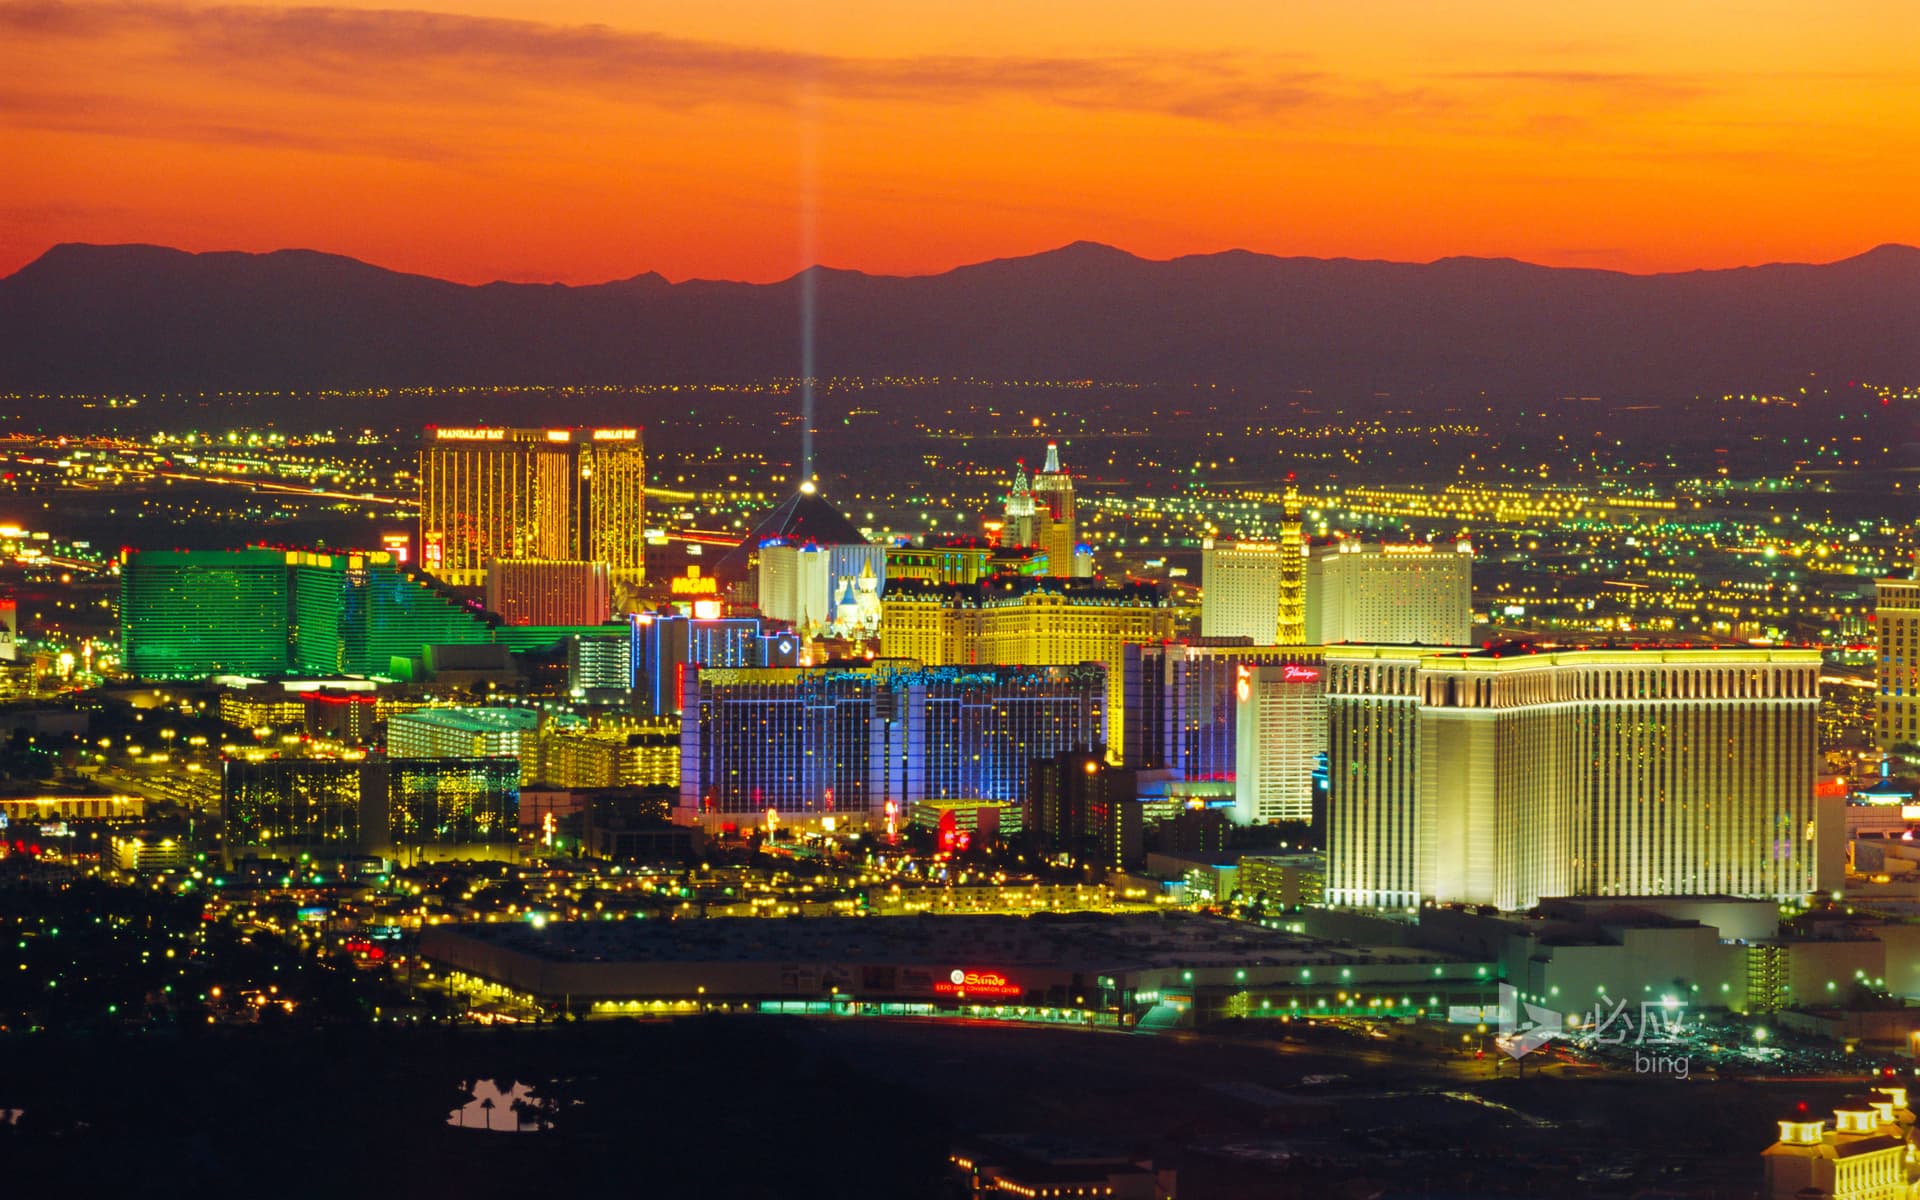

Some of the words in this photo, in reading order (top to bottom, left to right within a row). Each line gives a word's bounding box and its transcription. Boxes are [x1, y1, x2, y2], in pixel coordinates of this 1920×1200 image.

[437, 429, 486, 439] MANDALAY
[487, 429, 505, 439] BAY
[671, 577, 718, 594] MGM
[964, 973, 1006, 986] Sands
[966, 985, 1000, 993] CONVENTION
